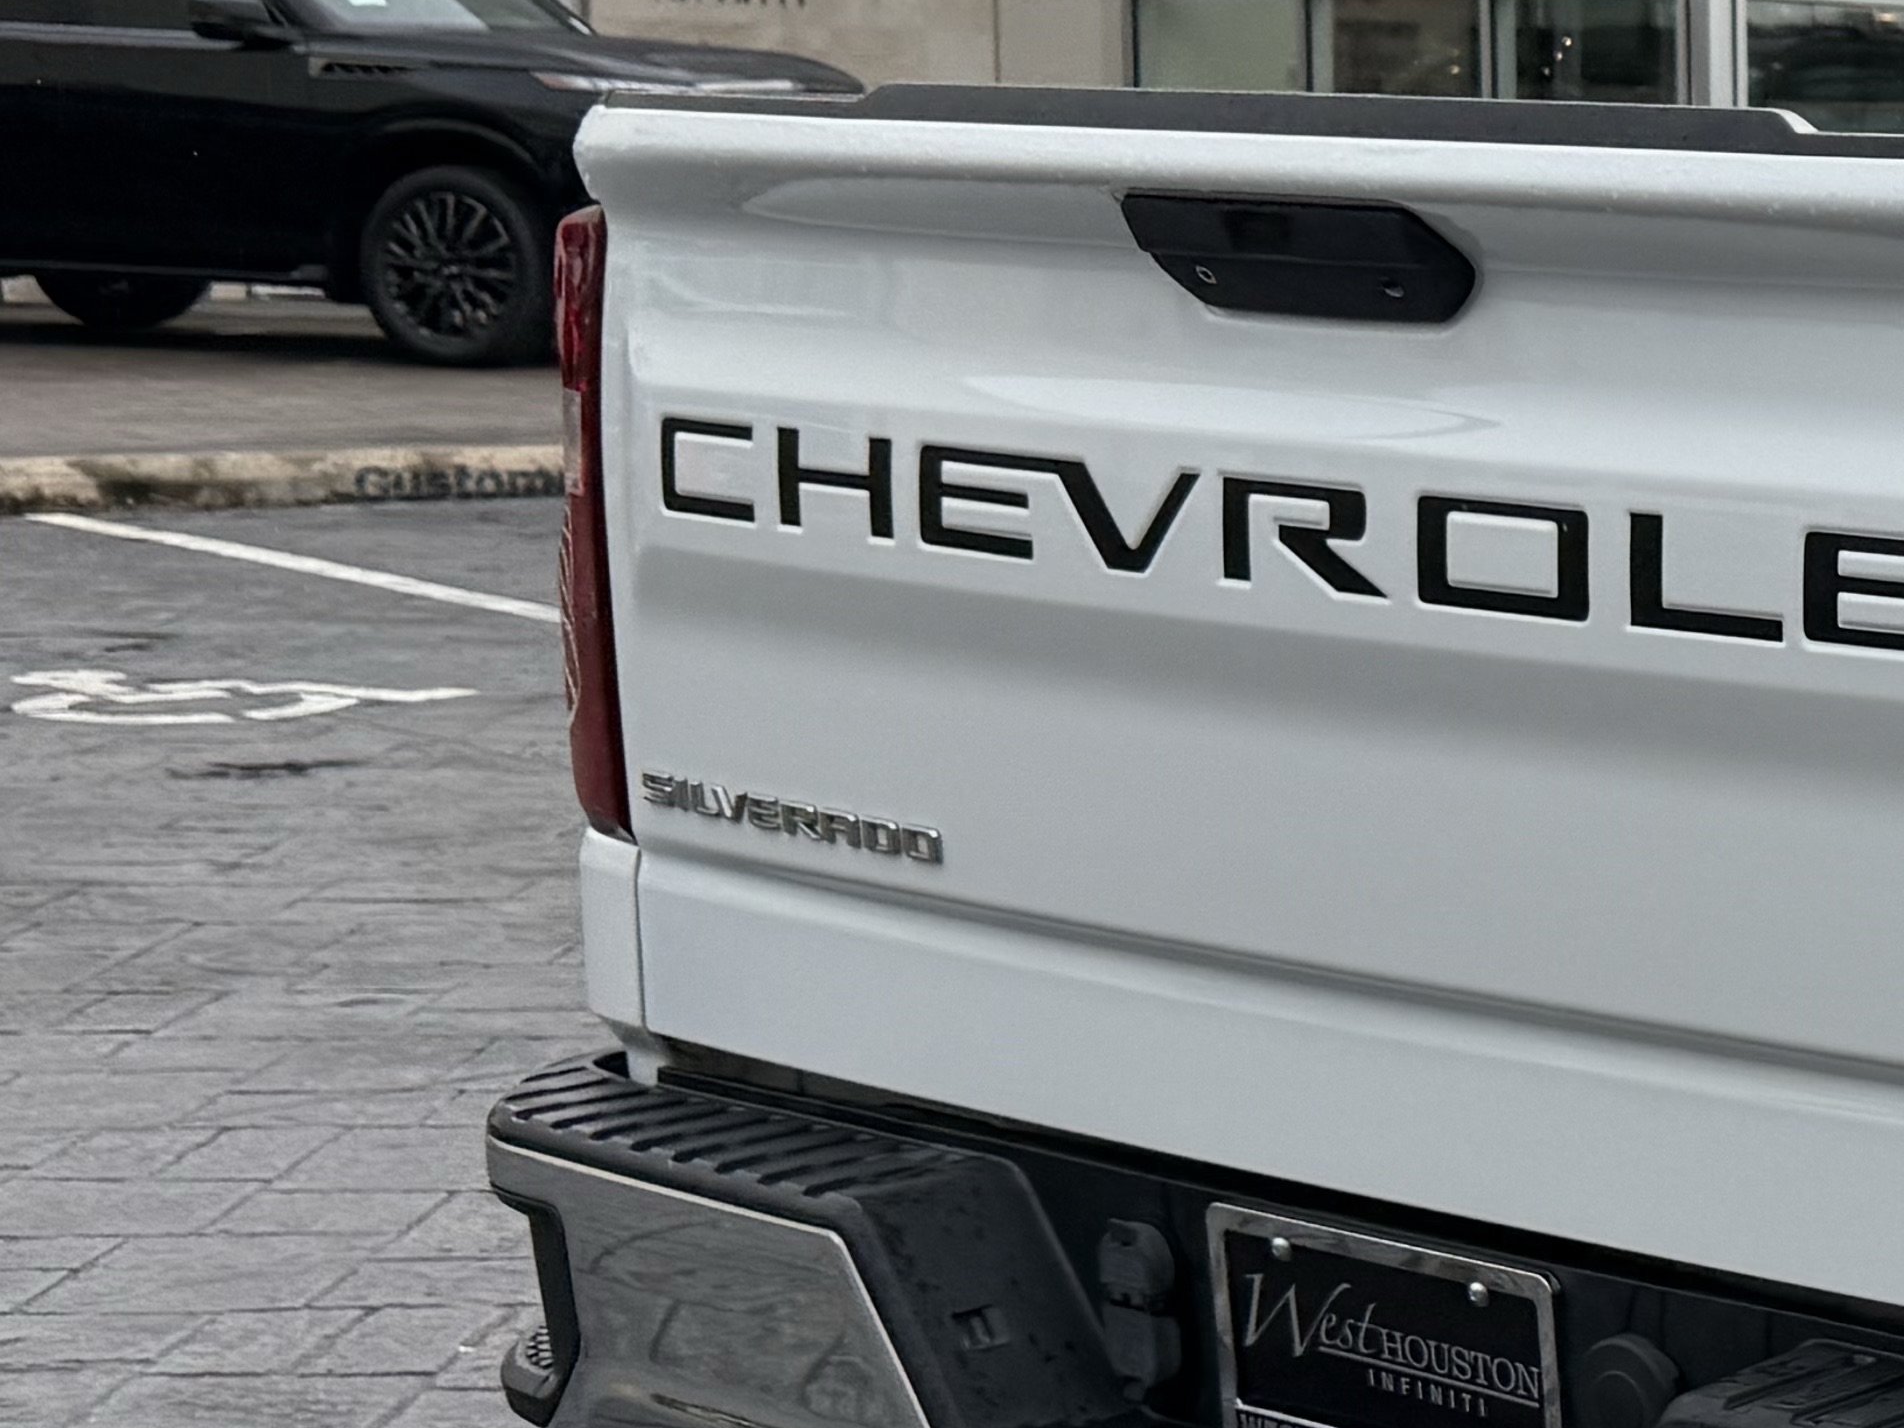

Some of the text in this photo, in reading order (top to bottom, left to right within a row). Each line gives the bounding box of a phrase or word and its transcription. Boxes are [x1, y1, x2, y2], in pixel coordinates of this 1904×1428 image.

[641, 769, 945, 865] SILVERADO
[1242, 1272, 1542, 1400] West HOUSTON
[1366, 1368, 1488, 1418] INFINITI
